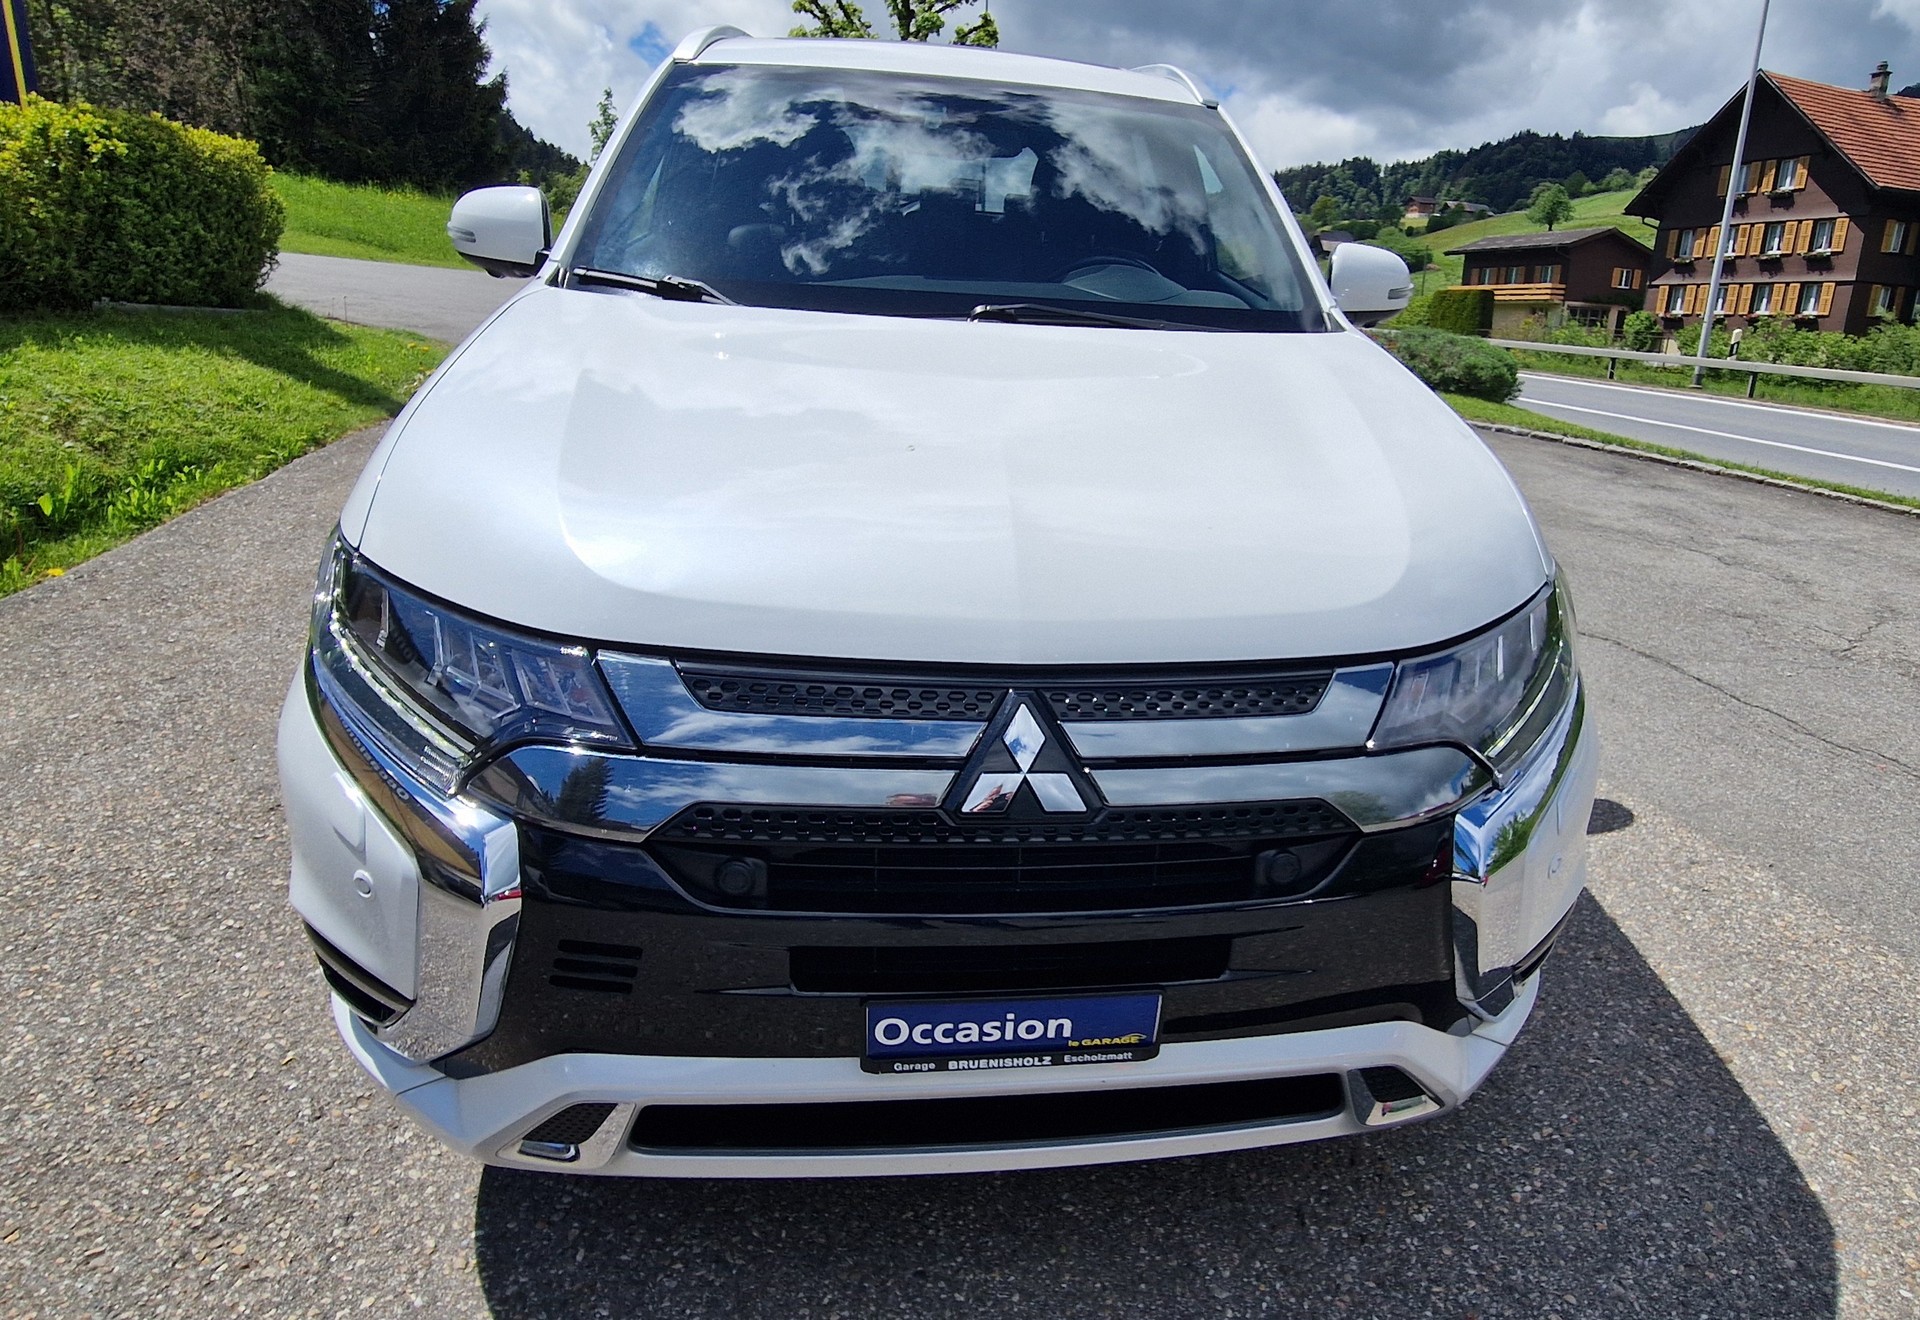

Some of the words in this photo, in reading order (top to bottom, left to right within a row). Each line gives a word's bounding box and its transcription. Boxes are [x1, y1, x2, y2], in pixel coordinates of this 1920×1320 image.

[874, 1013, 1073, 1046] Occasion
[1068, 1039, 1080, 1047] le
[1081, 1036, 1140, 1047] GARAGE
[893, 1061, 936, 1072] Garage
[948, 1056, 1052, 1071] BRUENISHOLZ
[1064, 1051, 1133, 1063] Escholzmatt
